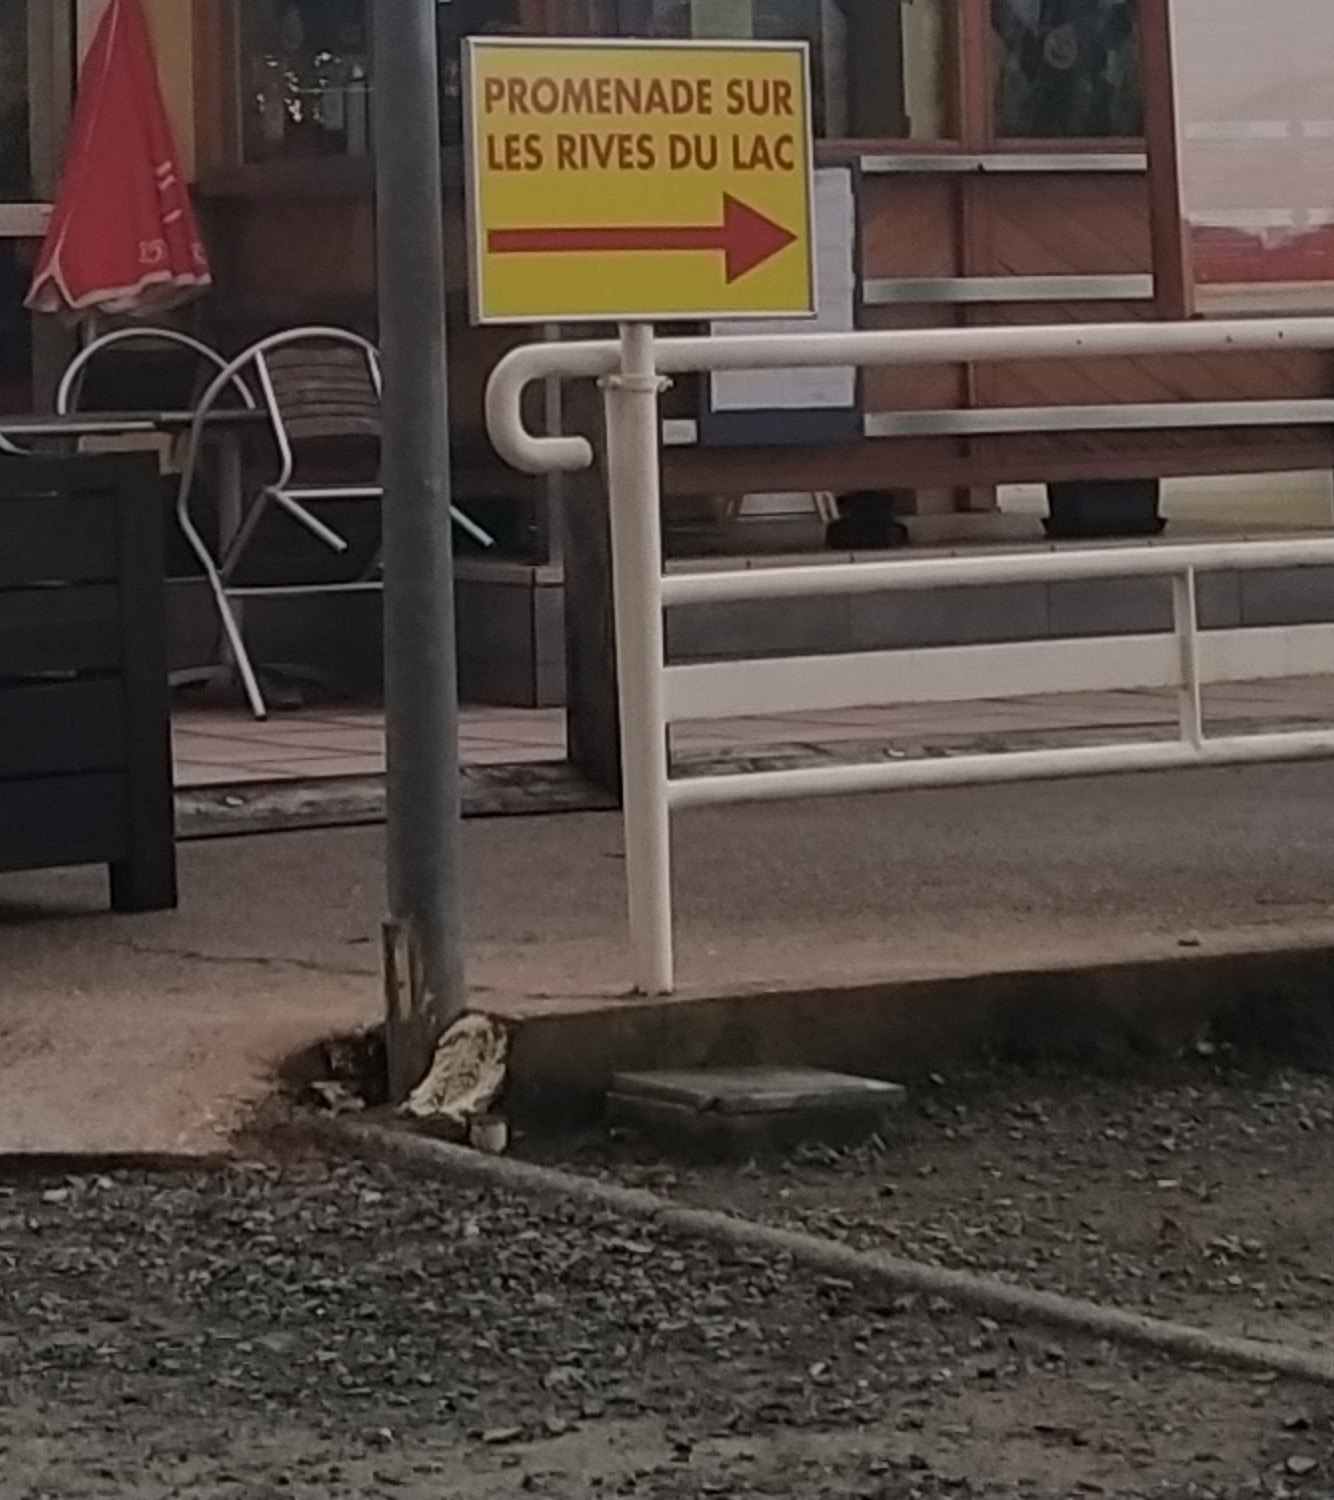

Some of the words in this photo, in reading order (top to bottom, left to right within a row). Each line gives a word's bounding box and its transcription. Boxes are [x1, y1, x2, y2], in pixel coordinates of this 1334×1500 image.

[484, 77, 712, 116] PROMENADE
[726, 79, 794, 117] SUR
[487, 133, 543, 171] LES
[557, 134, 656, 171] RIVES
[669, 134, 718, 170] DU
[732, 134, 794, 171] LAC
